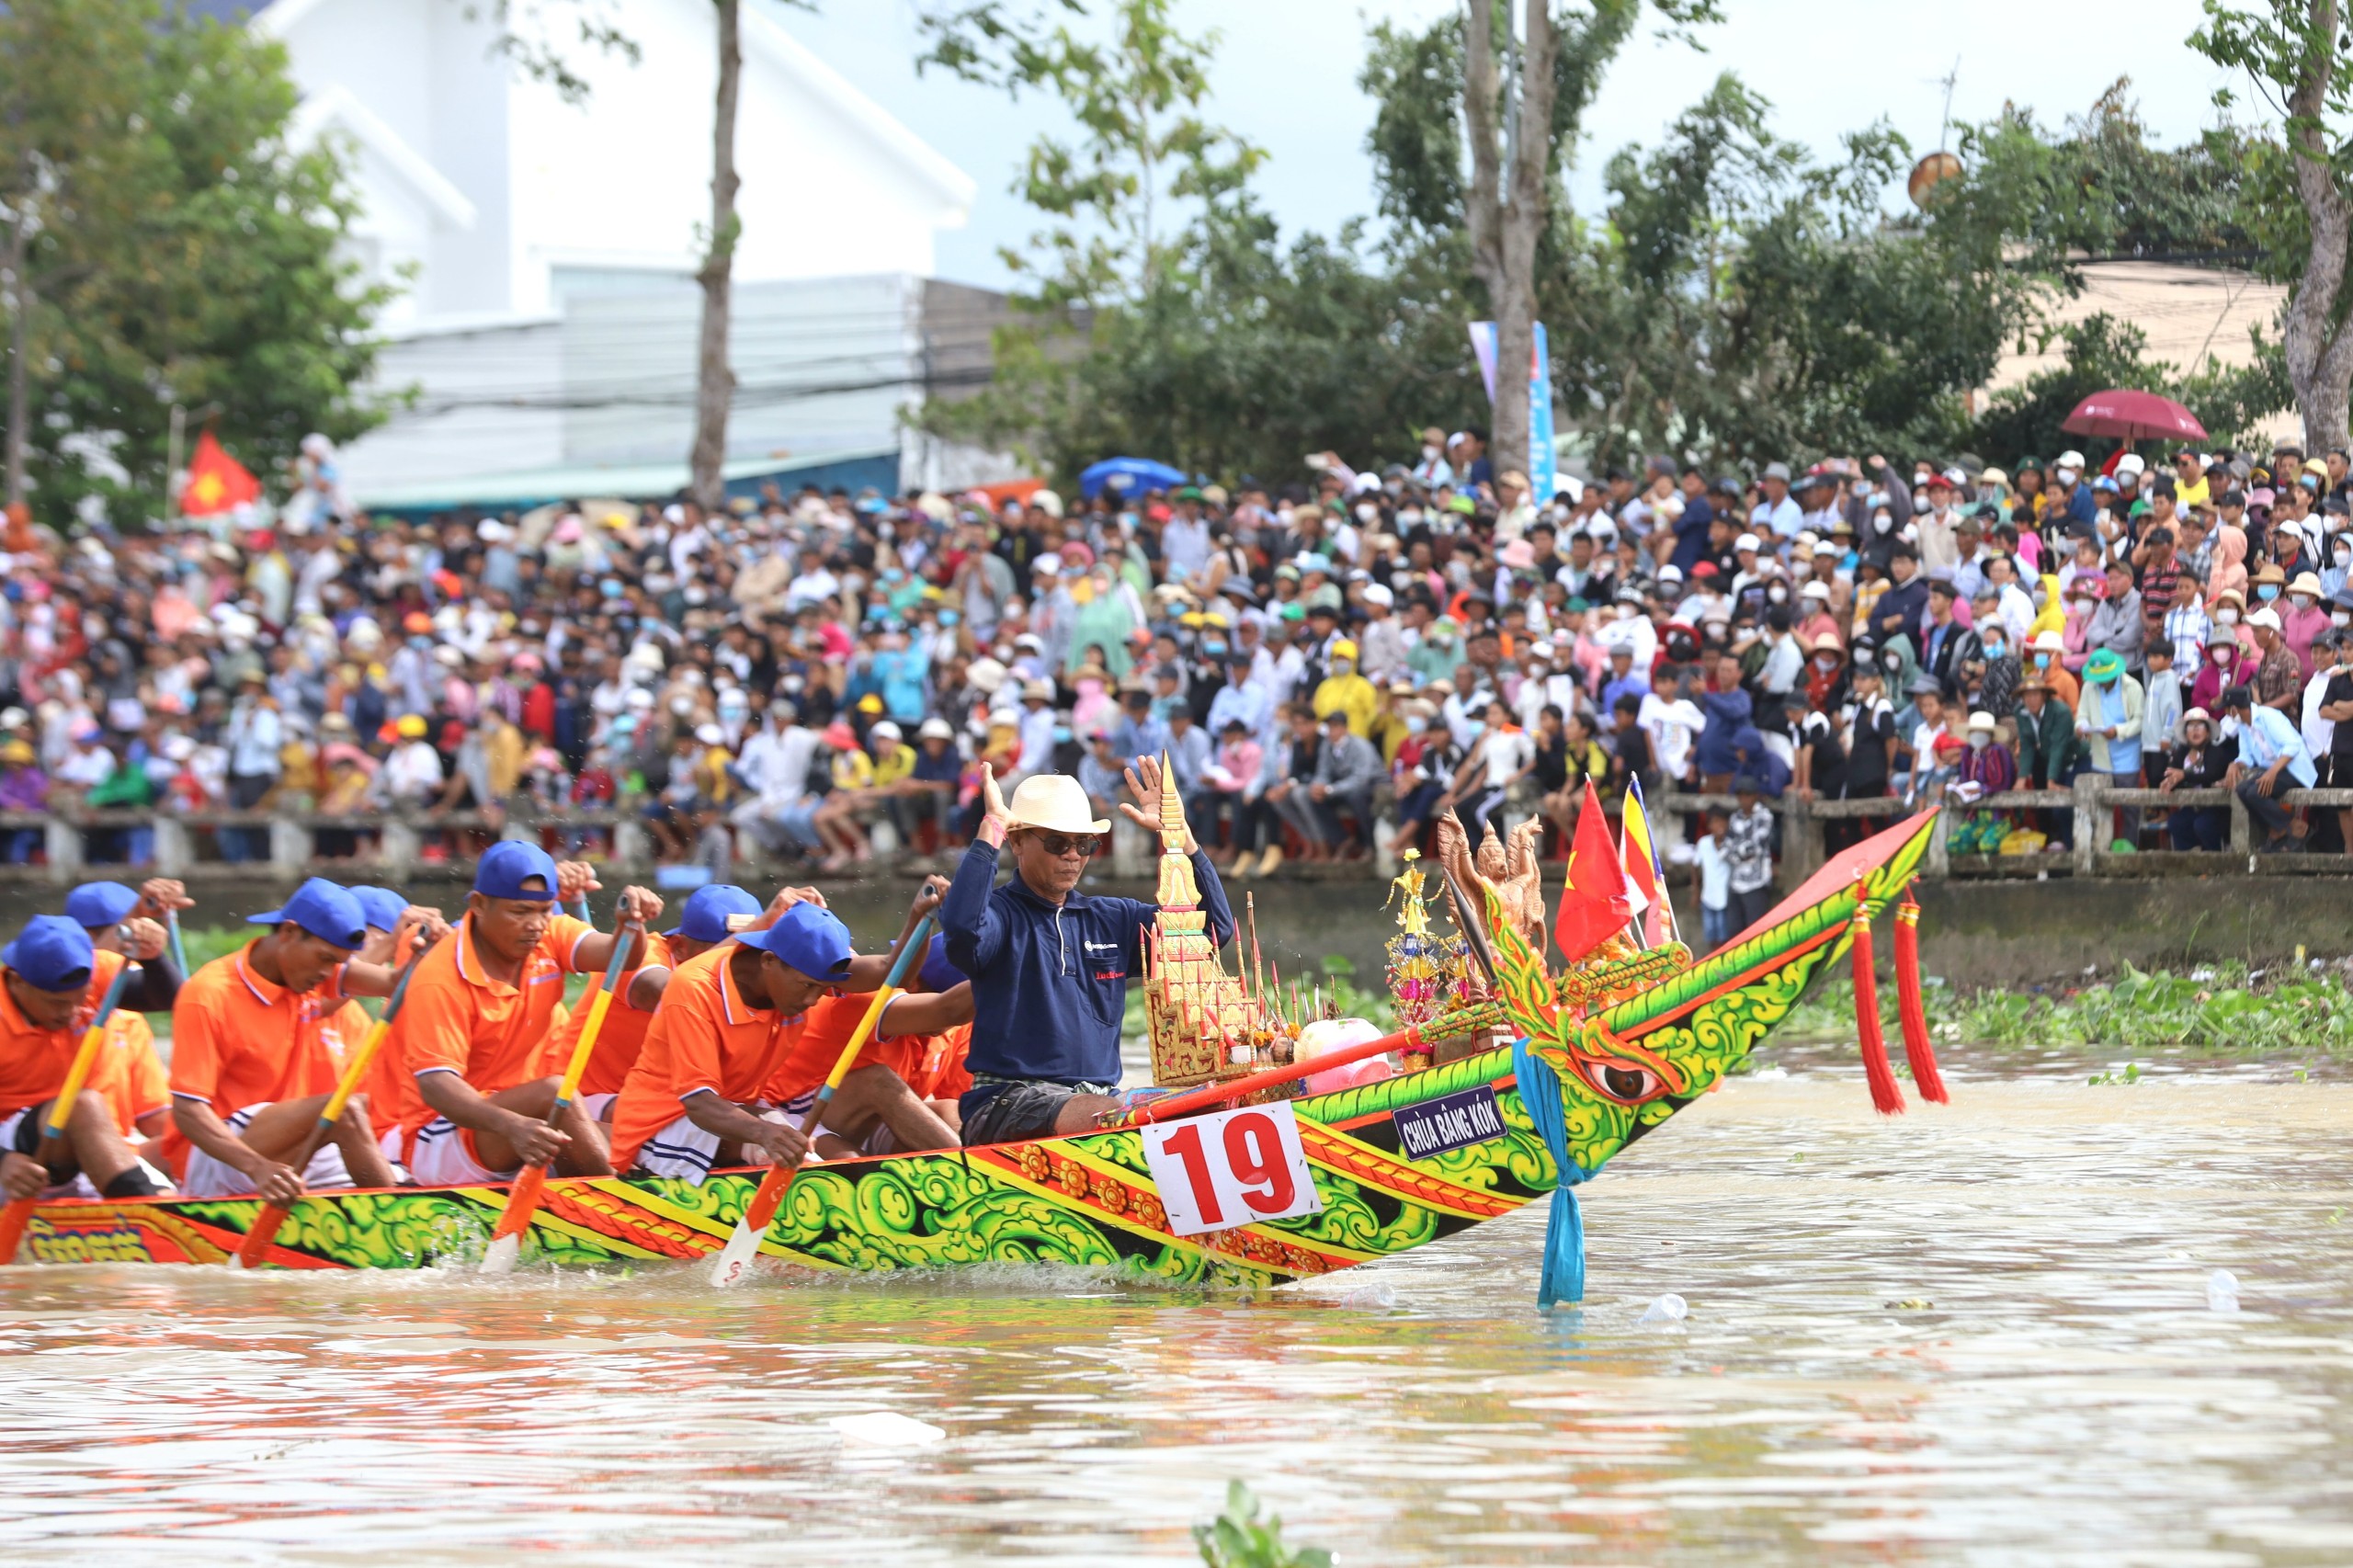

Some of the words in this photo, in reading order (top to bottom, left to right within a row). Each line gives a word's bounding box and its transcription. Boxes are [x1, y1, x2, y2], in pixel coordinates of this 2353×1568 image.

[1403, 1110, 1441, 1153] CHÙA
[1434, 1103, 1475, 1145] BÂNG
[1467, 1093, 1502, 1136] KÓK
[1162, 1112, 1296, 1225] 19
